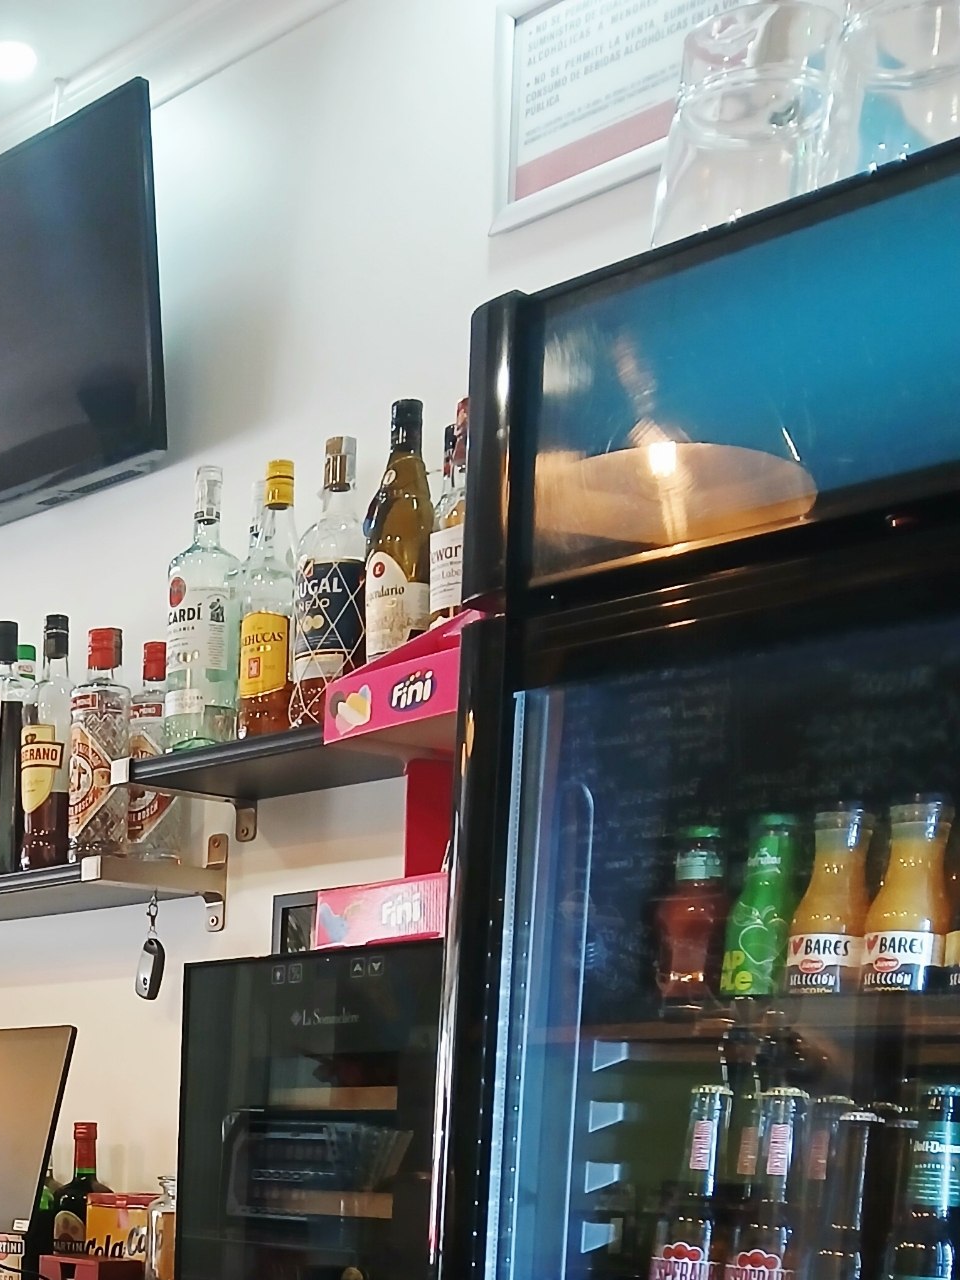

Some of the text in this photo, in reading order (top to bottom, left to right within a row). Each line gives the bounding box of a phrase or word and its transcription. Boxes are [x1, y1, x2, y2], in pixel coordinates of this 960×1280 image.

[525, 75, 568, 104] CONSUMO
[583, 49, 622, 75] BEBIDAS
[391, 669, 433, 709] Fini
[381, 892, 421, 926] Fini
[804, 938, 850, 957] BARES
